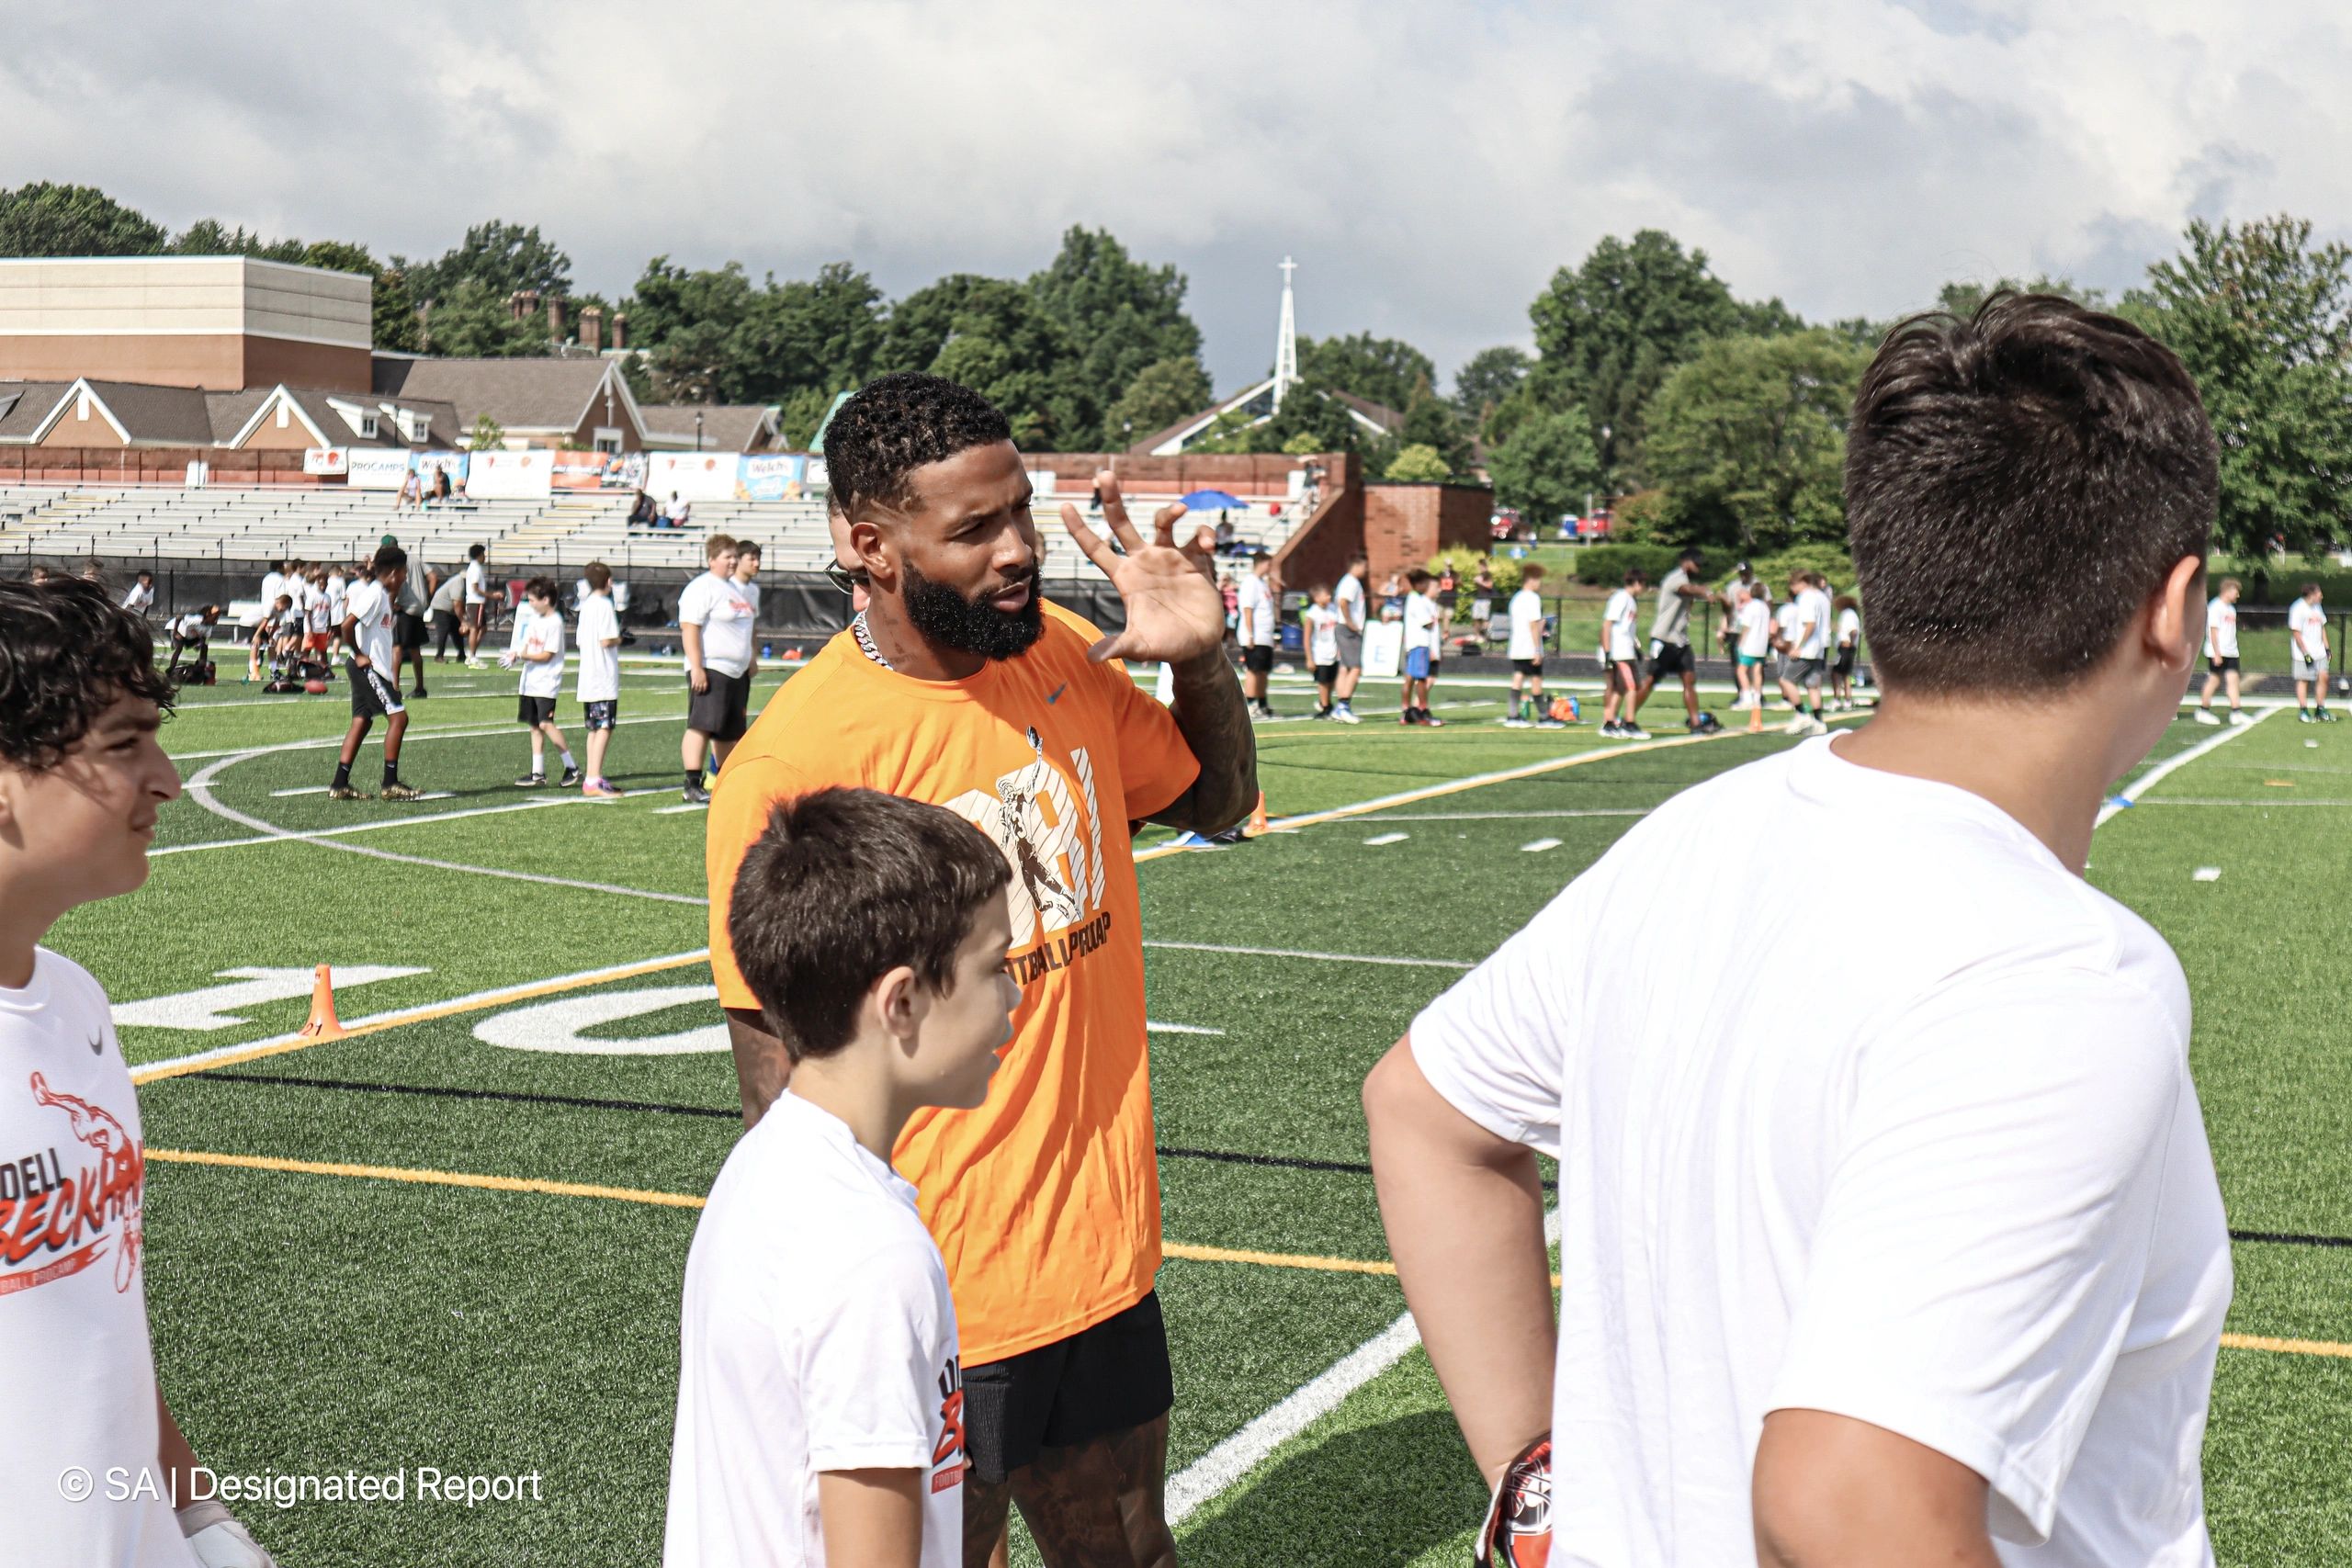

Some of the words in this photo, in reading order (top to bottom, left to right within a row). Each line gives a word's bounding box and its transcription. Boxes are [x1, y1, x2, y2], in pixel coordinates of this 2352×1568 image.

[351, 461, 405, 472] PROCAMPS
[1004, 938, 1070, 987] TBALL
[301, 1022, 323, 1036] 21
